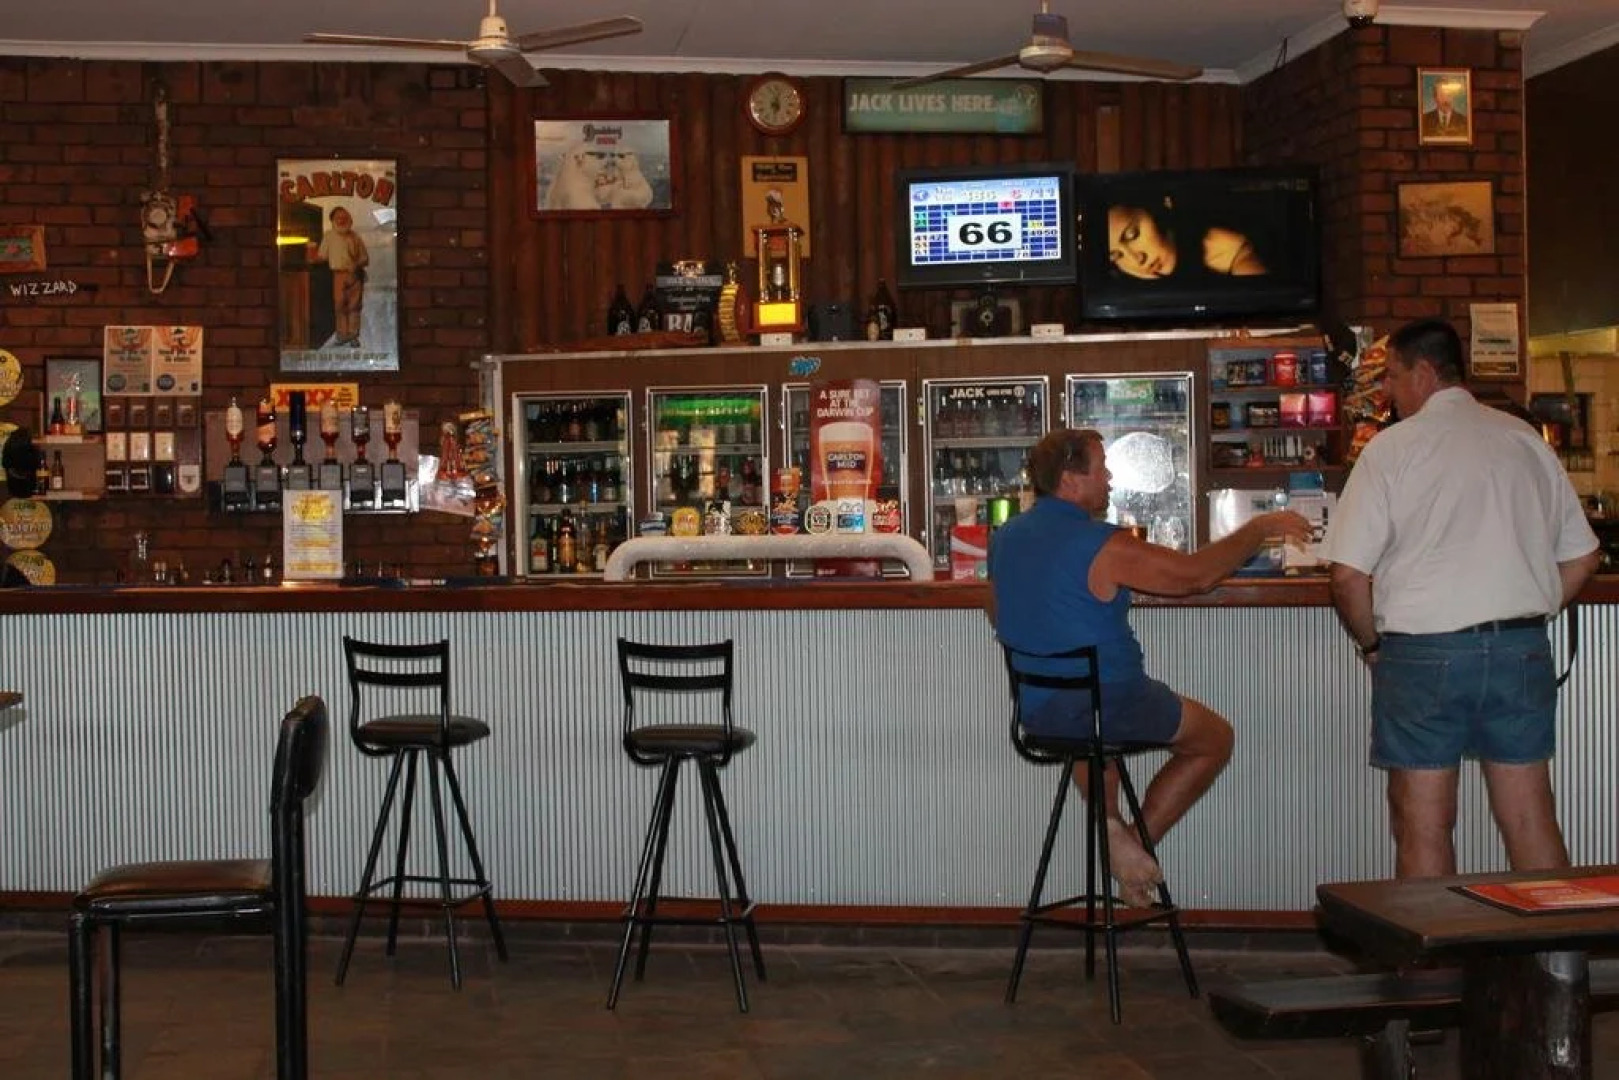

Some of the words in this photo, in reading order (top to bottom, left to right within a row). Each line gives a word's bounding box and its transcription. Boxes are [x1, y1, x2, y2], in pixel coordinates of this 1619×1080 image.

[849, 94, 892, 112] JACK
[899, 94, 946, 112] LIVES
[951, 94, 995, 112] HERE
[280, 170, 395, 207] CARLTON
[959, 221, 1013, 246] 66
[10, 280, 77, 296] WIZZARD
[820, 389, 827, 399] A
[950, 387, 985, 399] JACK
[830, 399, 841, 408] AT
[816, 407, 855, 417] DARWIN
[828, 452, 866, 461] CARLTON
[836, 460, 857, 469] MID
